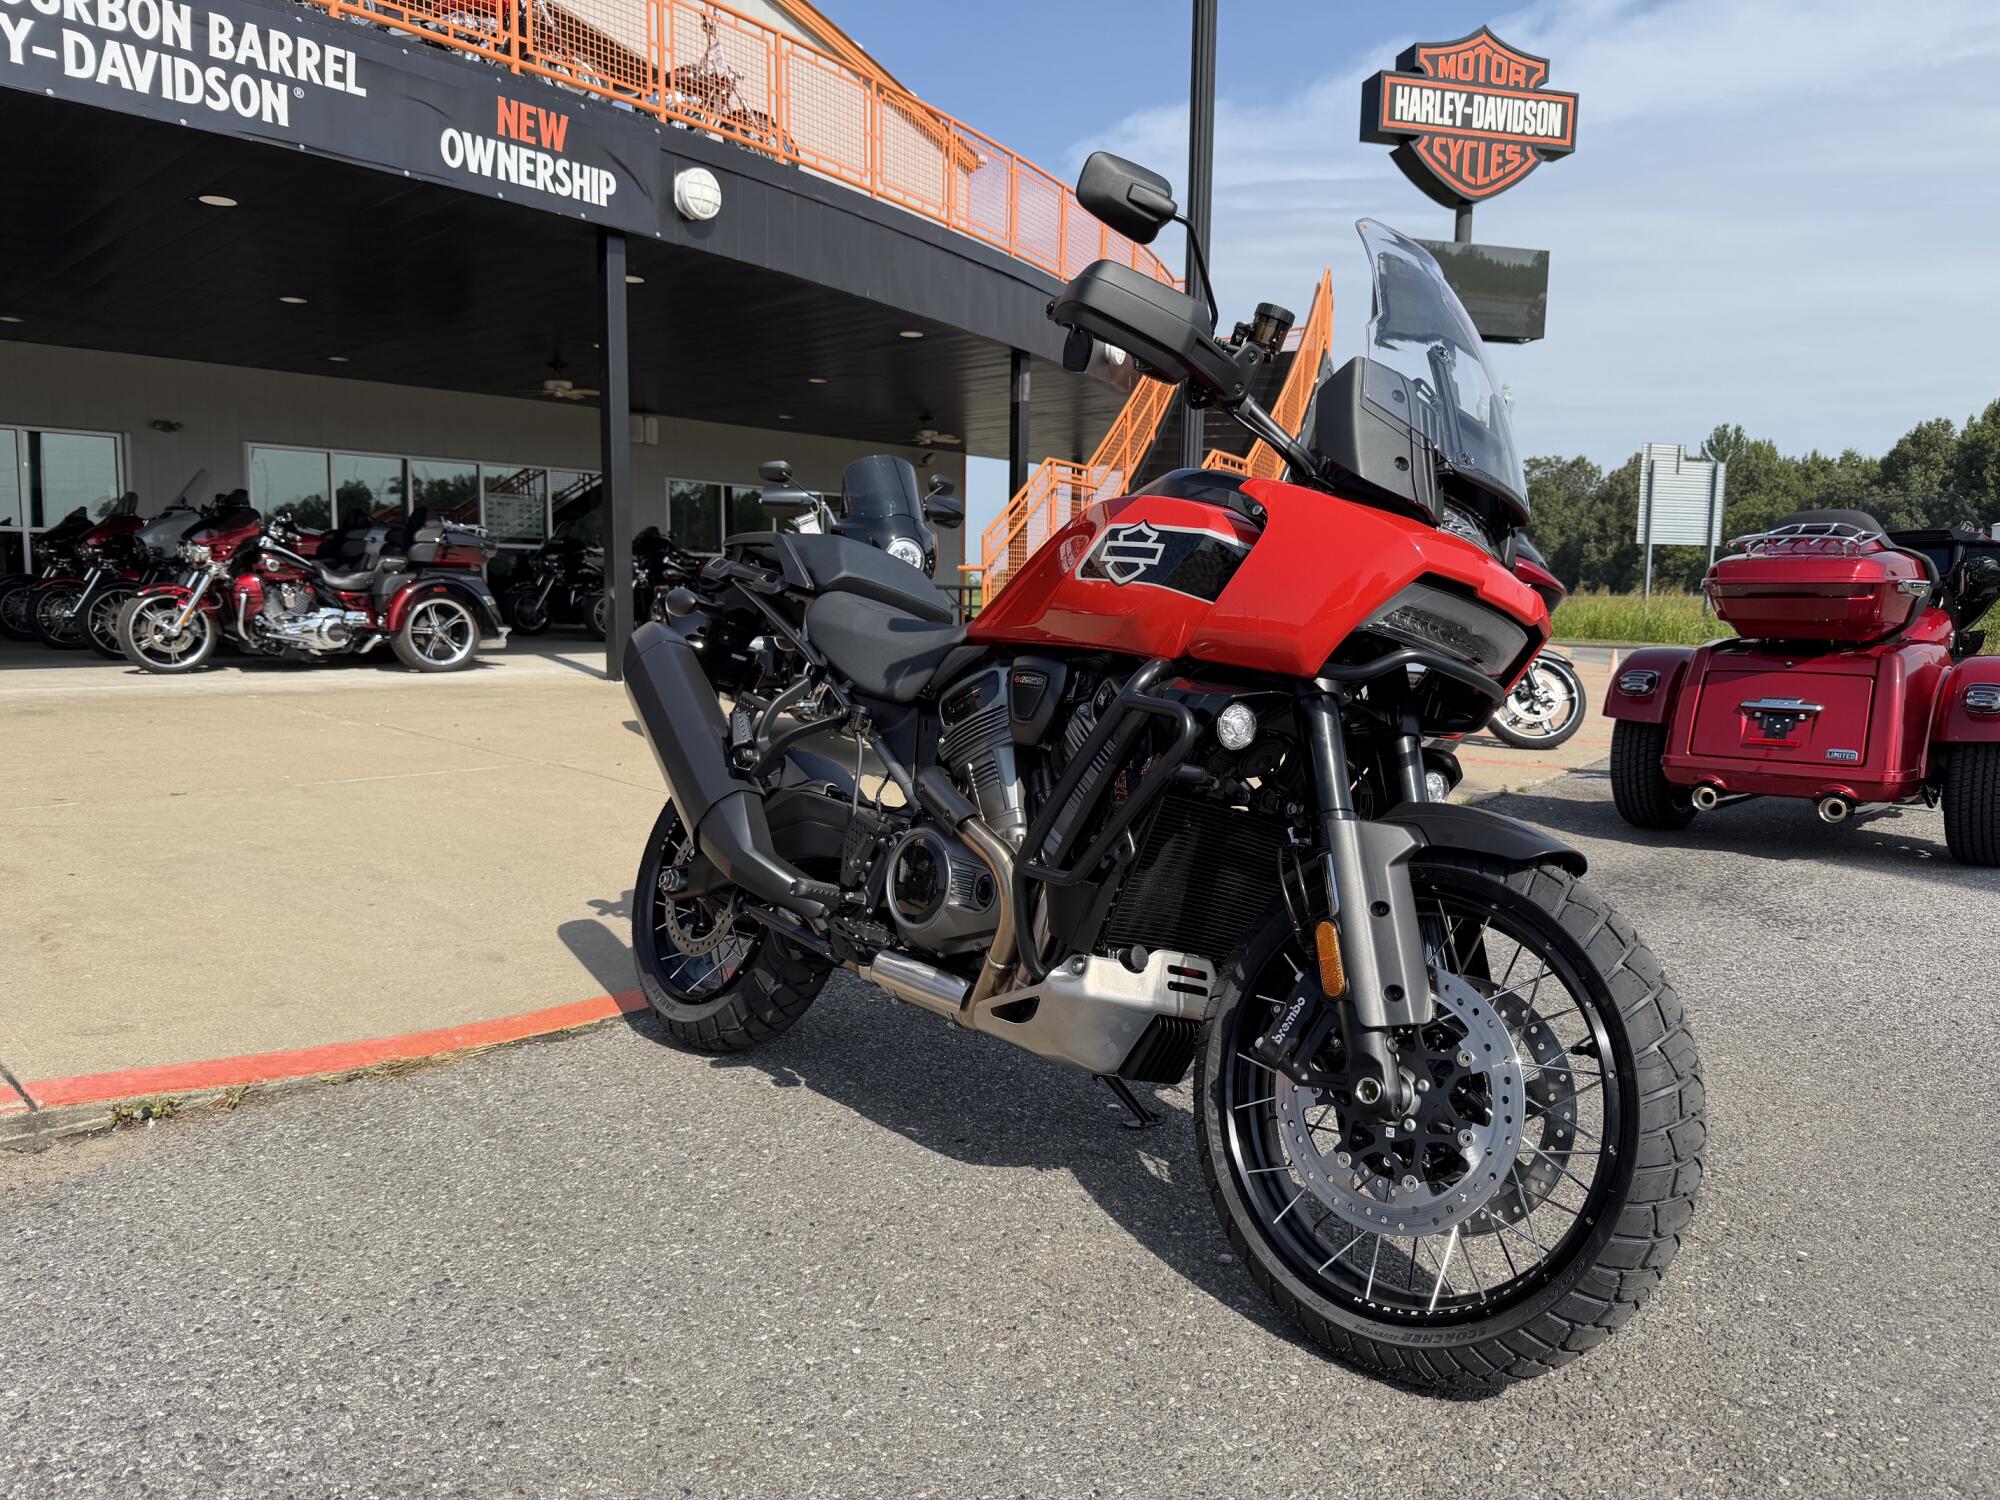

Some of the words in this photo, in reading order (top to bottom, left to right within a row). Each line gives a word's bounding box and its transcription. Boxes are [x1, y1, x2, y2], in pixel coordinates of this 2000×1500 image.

[208, 12, 367, 98] BARREL
[1438, 44, 1527, 88] MOTOR
[497, 95, 569, 153] NEW
[1395, 85, 1562, 137] HARLEY-DAVIDSON
[440, 128, 617, 207] OWNERSHIP
[1433, 136, 1522, 186] CYCLES
[1827, 751, 1856, 760] LIMITED
[1271, 996, 1306, 1045] brembo
